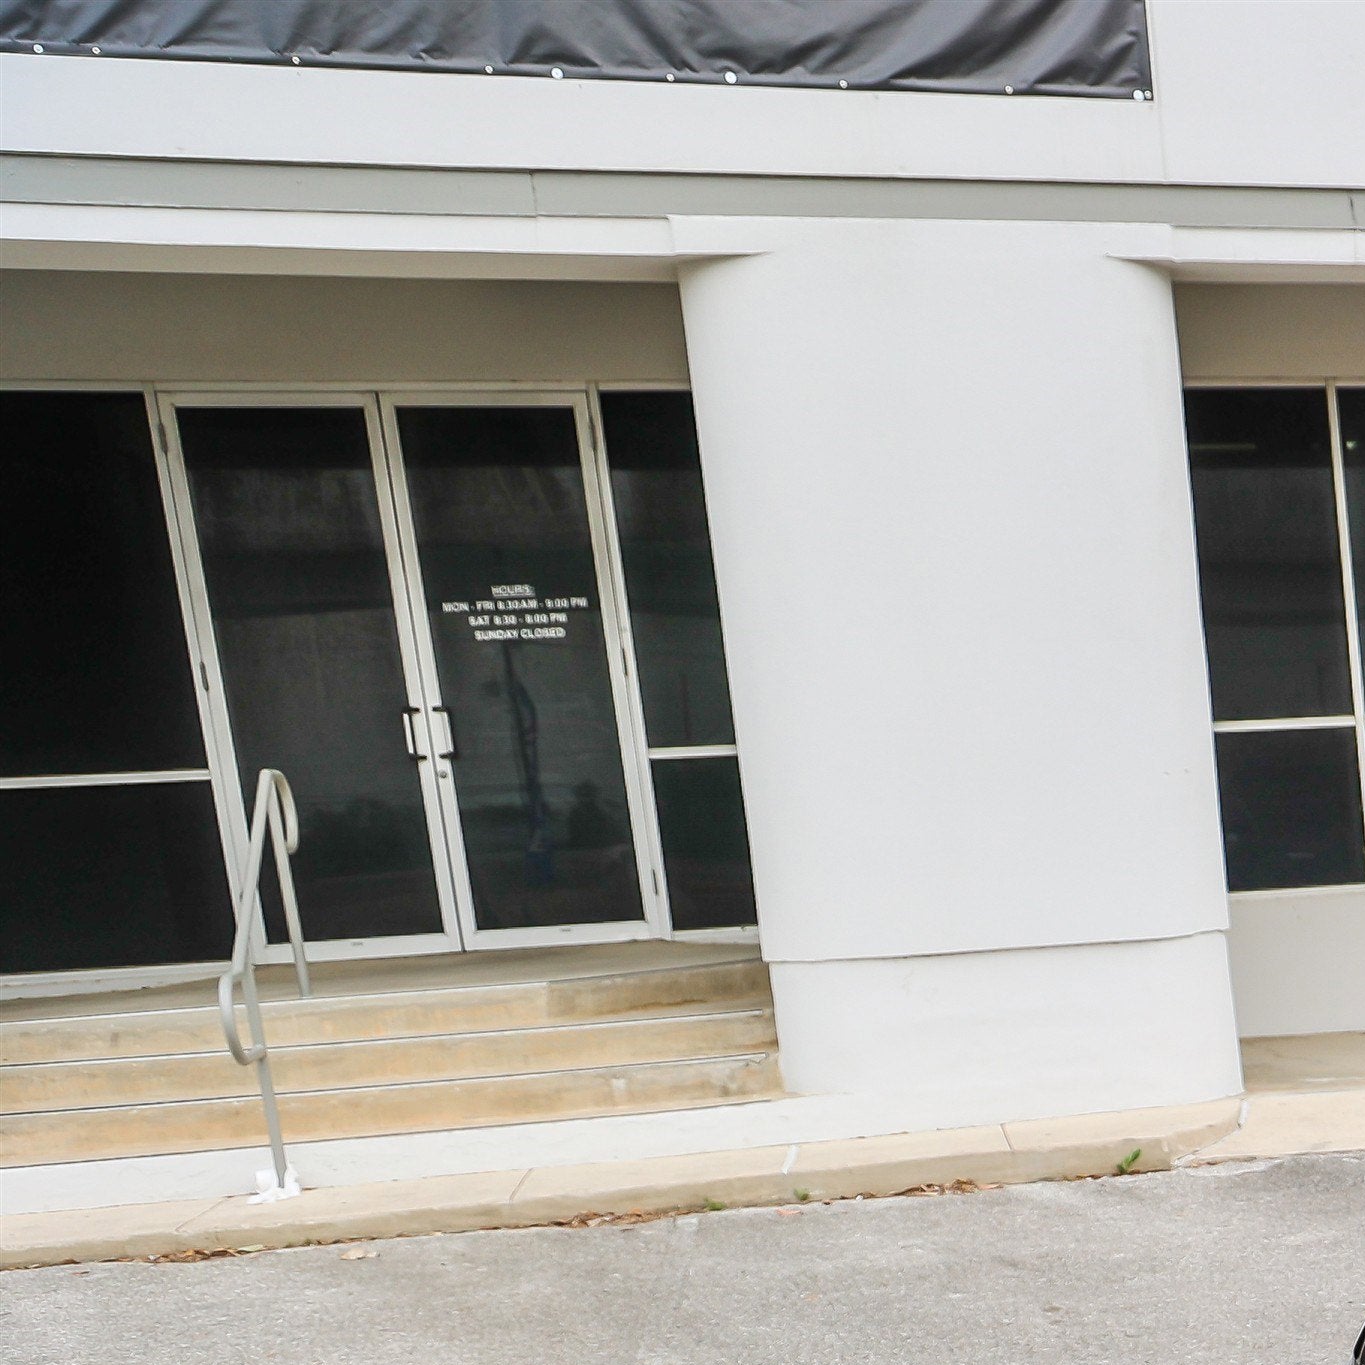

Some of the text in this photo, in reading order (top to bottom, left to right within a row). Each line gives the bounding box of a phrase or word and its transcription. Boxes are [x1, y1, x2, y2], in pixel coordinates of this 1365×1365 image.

[442, 602, 469, 612] MON
[468, 615, 490, 627] SAT
[474, 627, 567, 641] SUNDAY CLOSED
